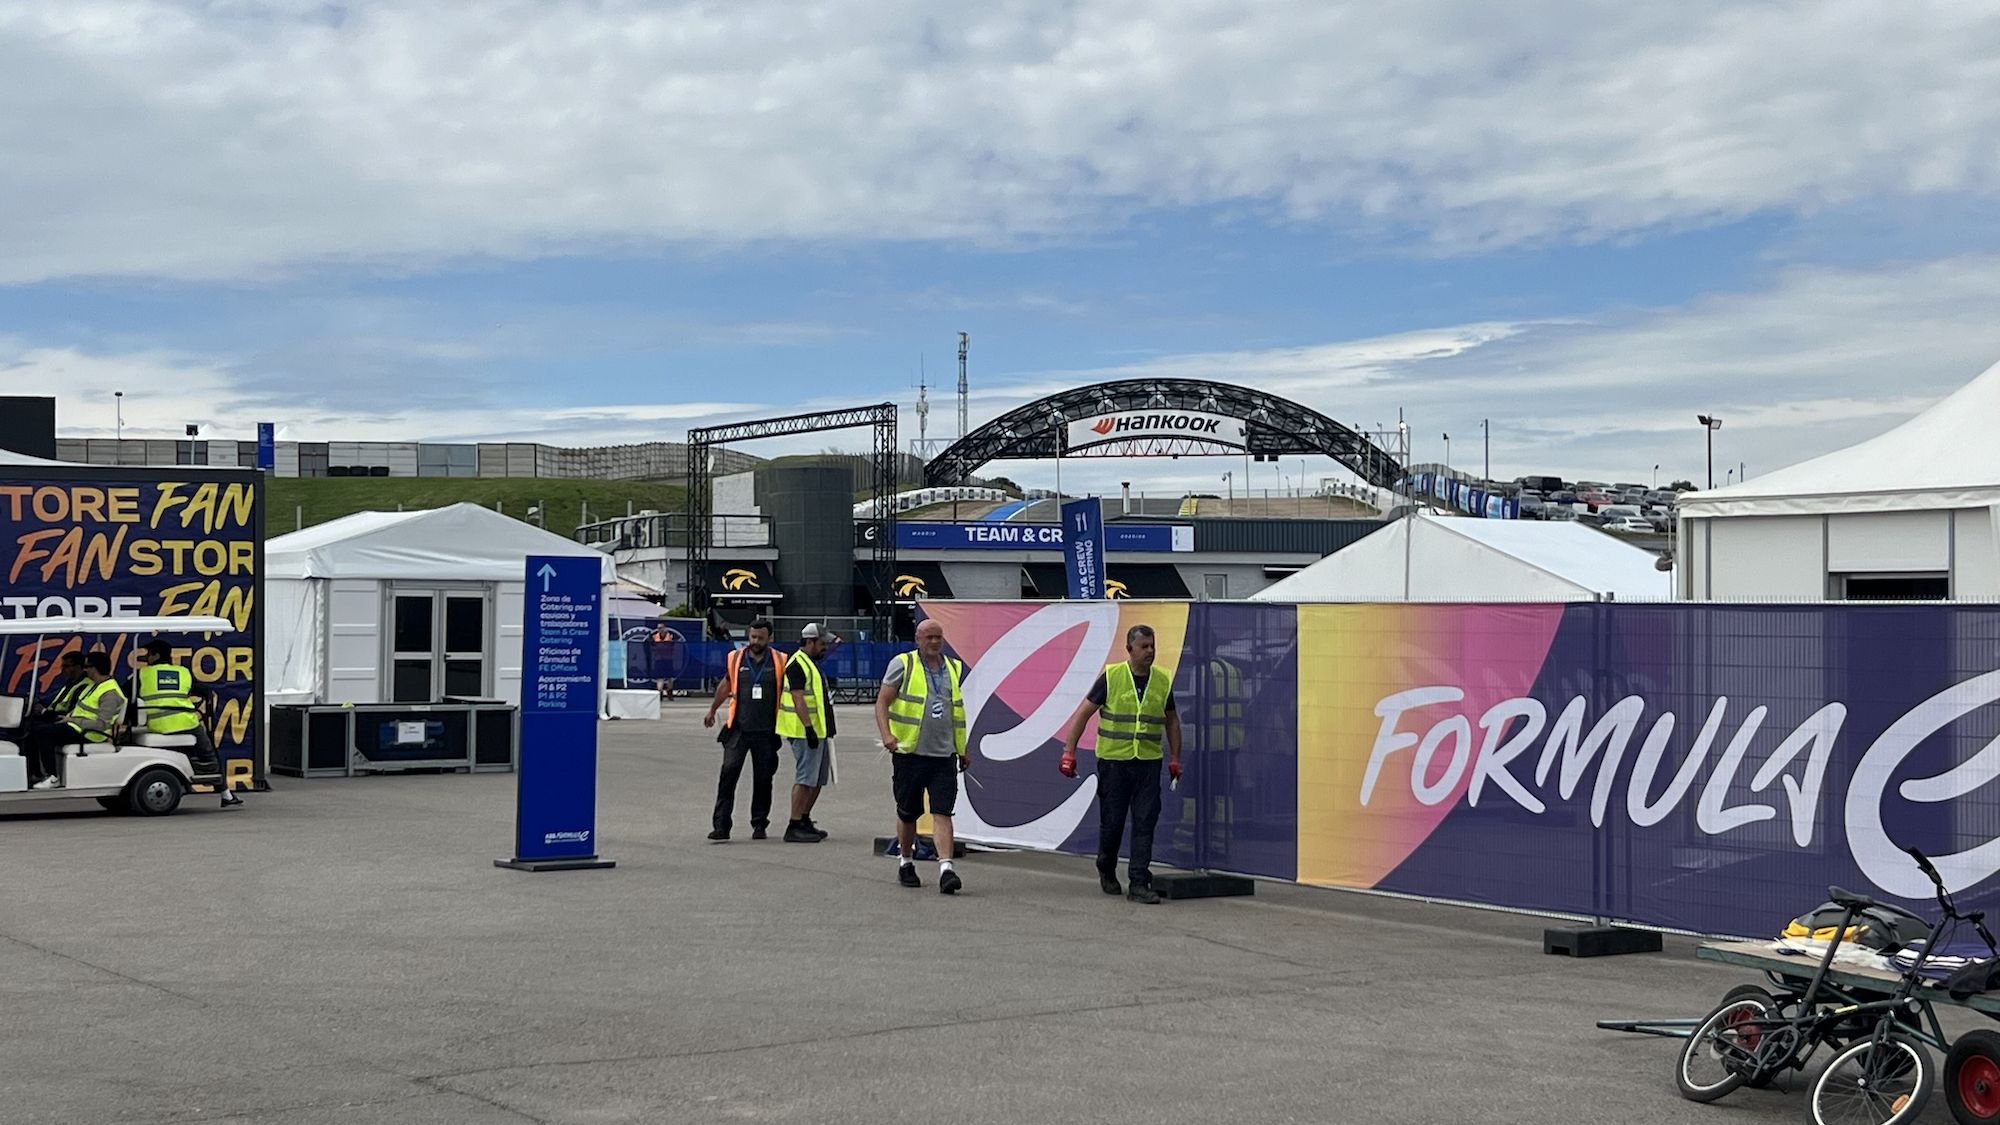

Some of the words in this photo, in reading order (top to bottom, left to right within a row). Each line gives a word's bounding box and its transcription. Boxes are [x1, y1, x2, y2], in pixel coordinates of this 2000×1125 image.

[0, 486, 141, 522] TORE
[150, 482, 254, 535] FAN
[964, 527, 1019, 542] TEAM
[1022, 528, 1036, 543] &
[1038, 528, 1064, 543] CR
[9, 524, 128, 589] FAN
[128, 540, 254, 576] STOR
[1074, 541, 1088, 576] CREW
[1084, 539, 1096, 596] CATERING
[0, 596, 142, 619] TORE
[540, 594, 560, 602] Zona
[540, 603, 573, 612] Catering
[575, 604, 592, 612] para
[540, 620, 588, 628] trabajadores
[540, 636, 573, 645] Catering
[539, 647, 571, 655] Oficinas
[571, 647, 581, 655] de
[538, 683, 548, 691] P1
[556, 683, 567, 691] P2
[538, 700, 567, 708] Parking
[1359, 685, 1848, 848] FORMULA
